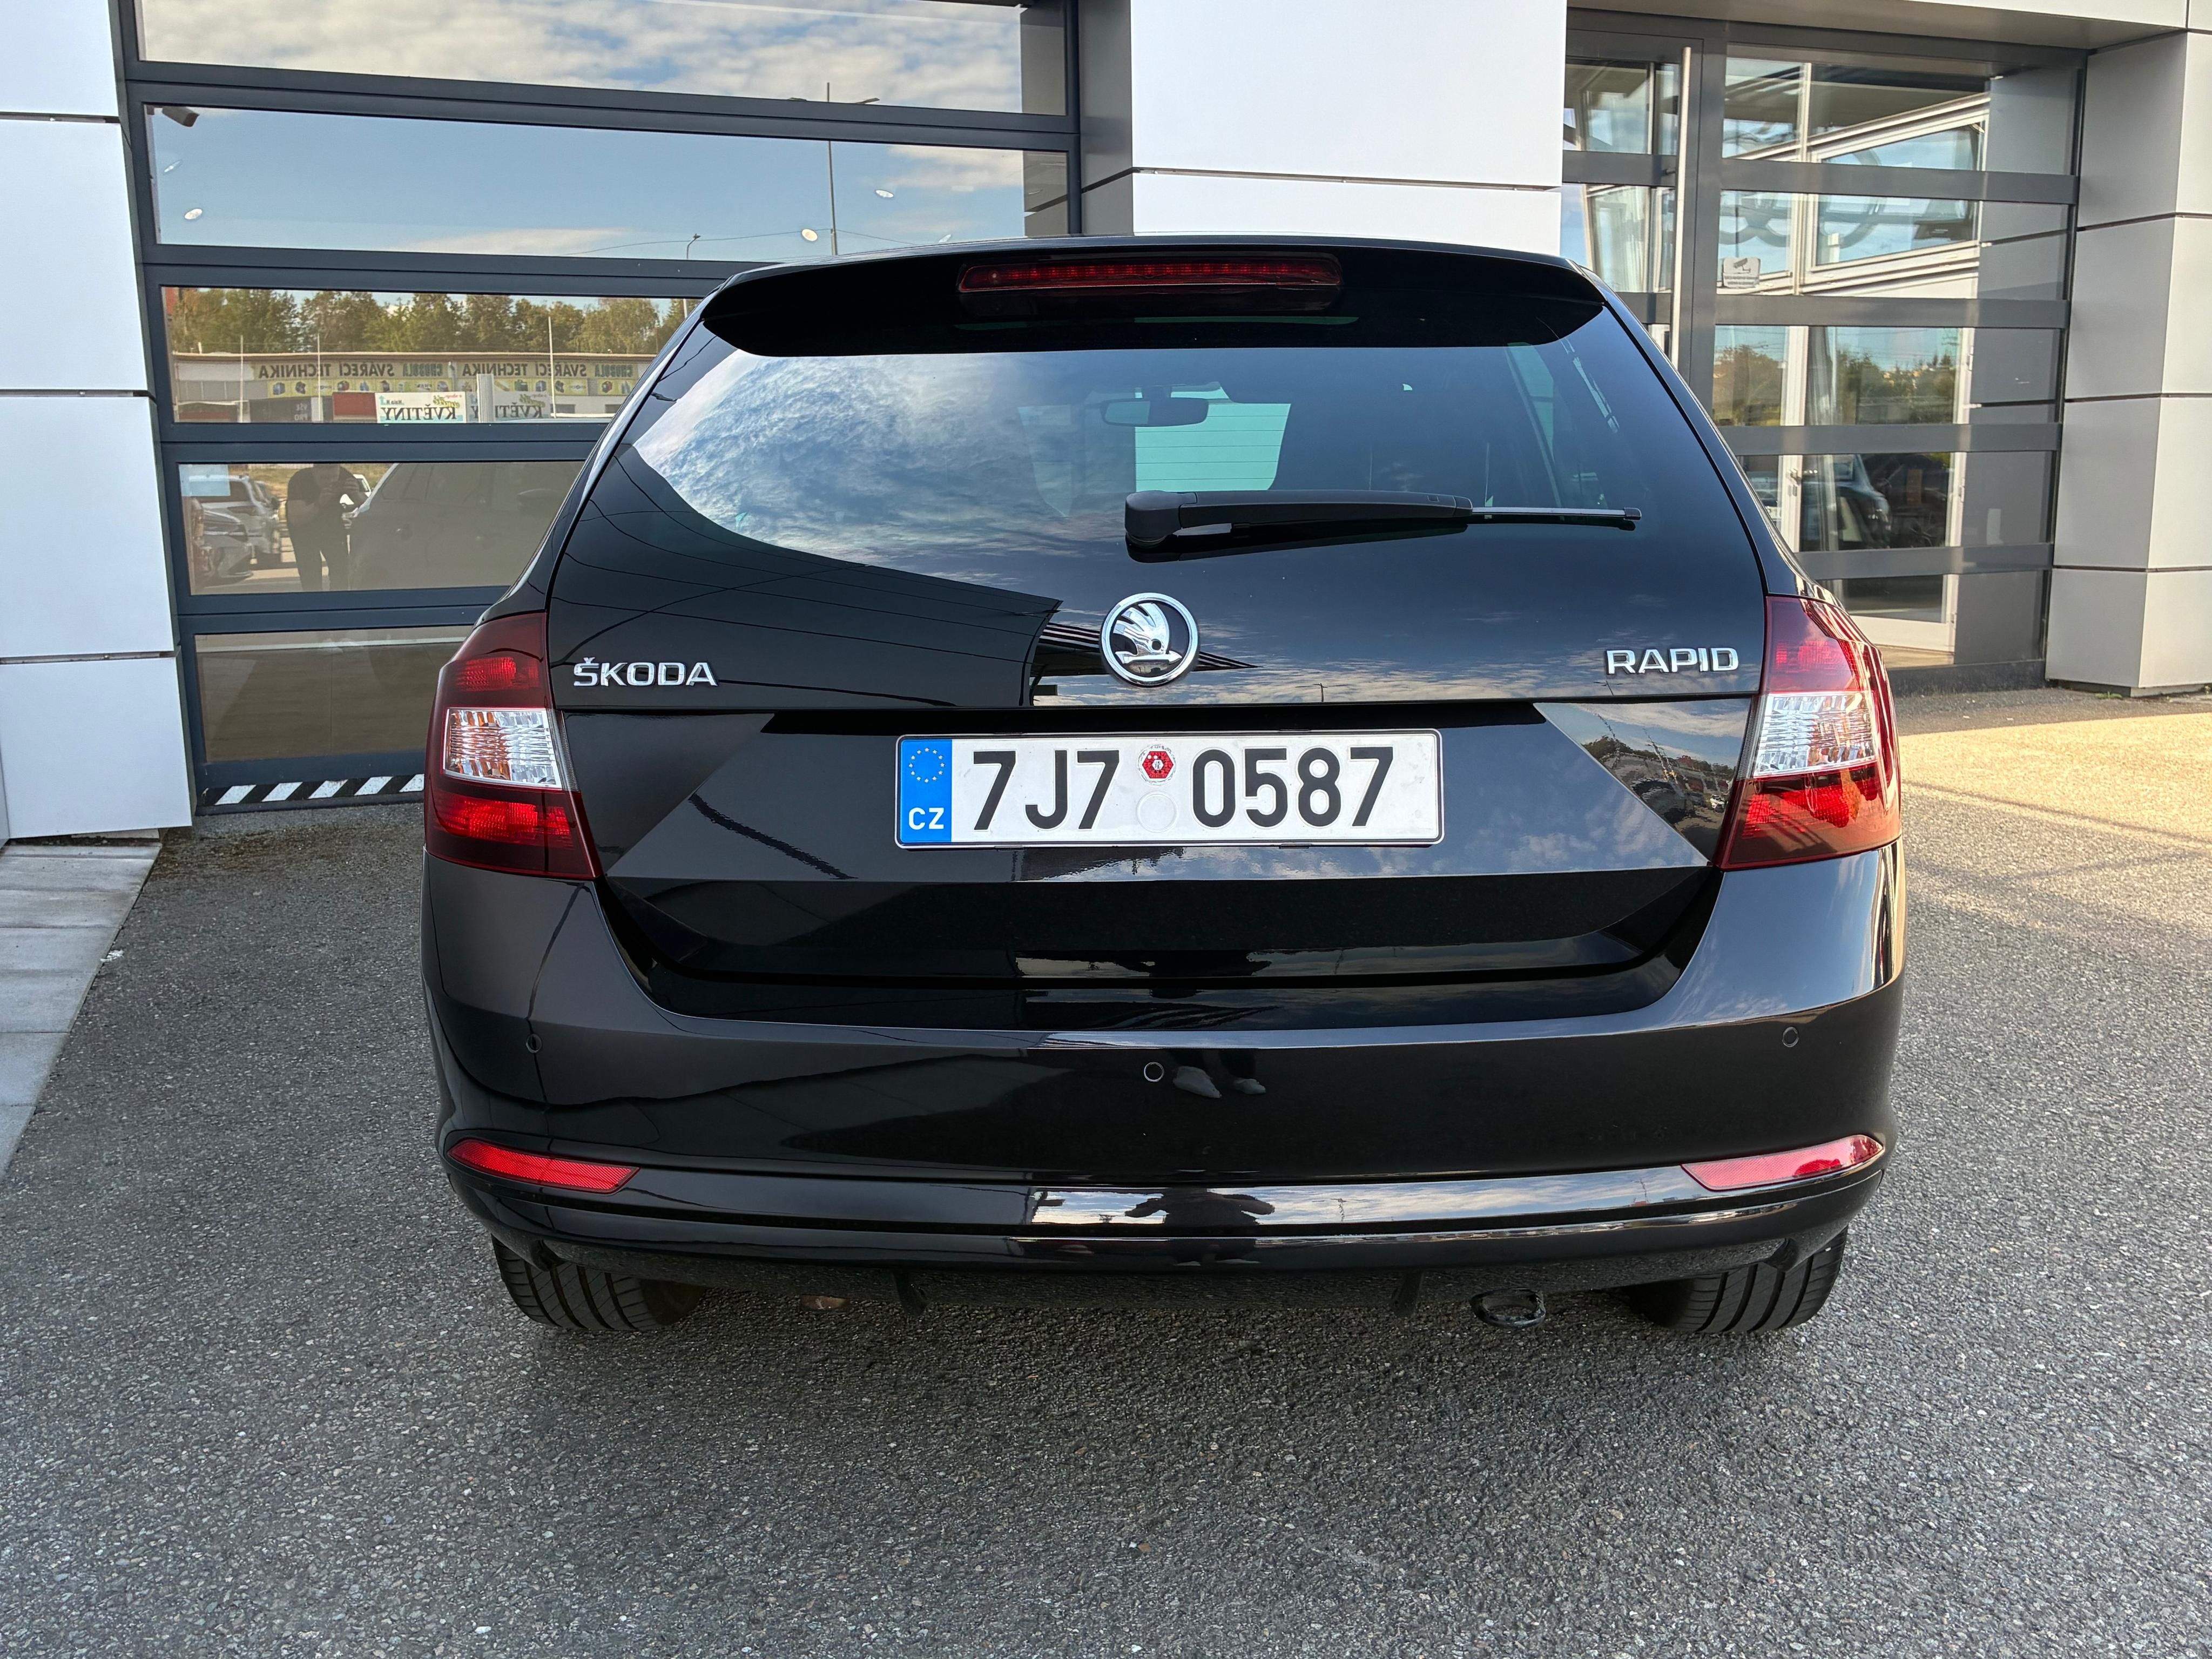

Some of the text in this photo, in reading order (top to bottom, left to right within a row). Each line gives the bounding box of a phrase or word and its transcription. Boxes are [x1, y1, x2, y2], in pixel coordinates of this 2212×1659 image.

[574, 657, 718, 686] ŠKODA
[1606, 648, 1739, 675] RAPID
[973, 749, 1120, 831] 7J7
[1192, 746, 1394, 828] 0587
[908, 807, 945, 830] CZ
